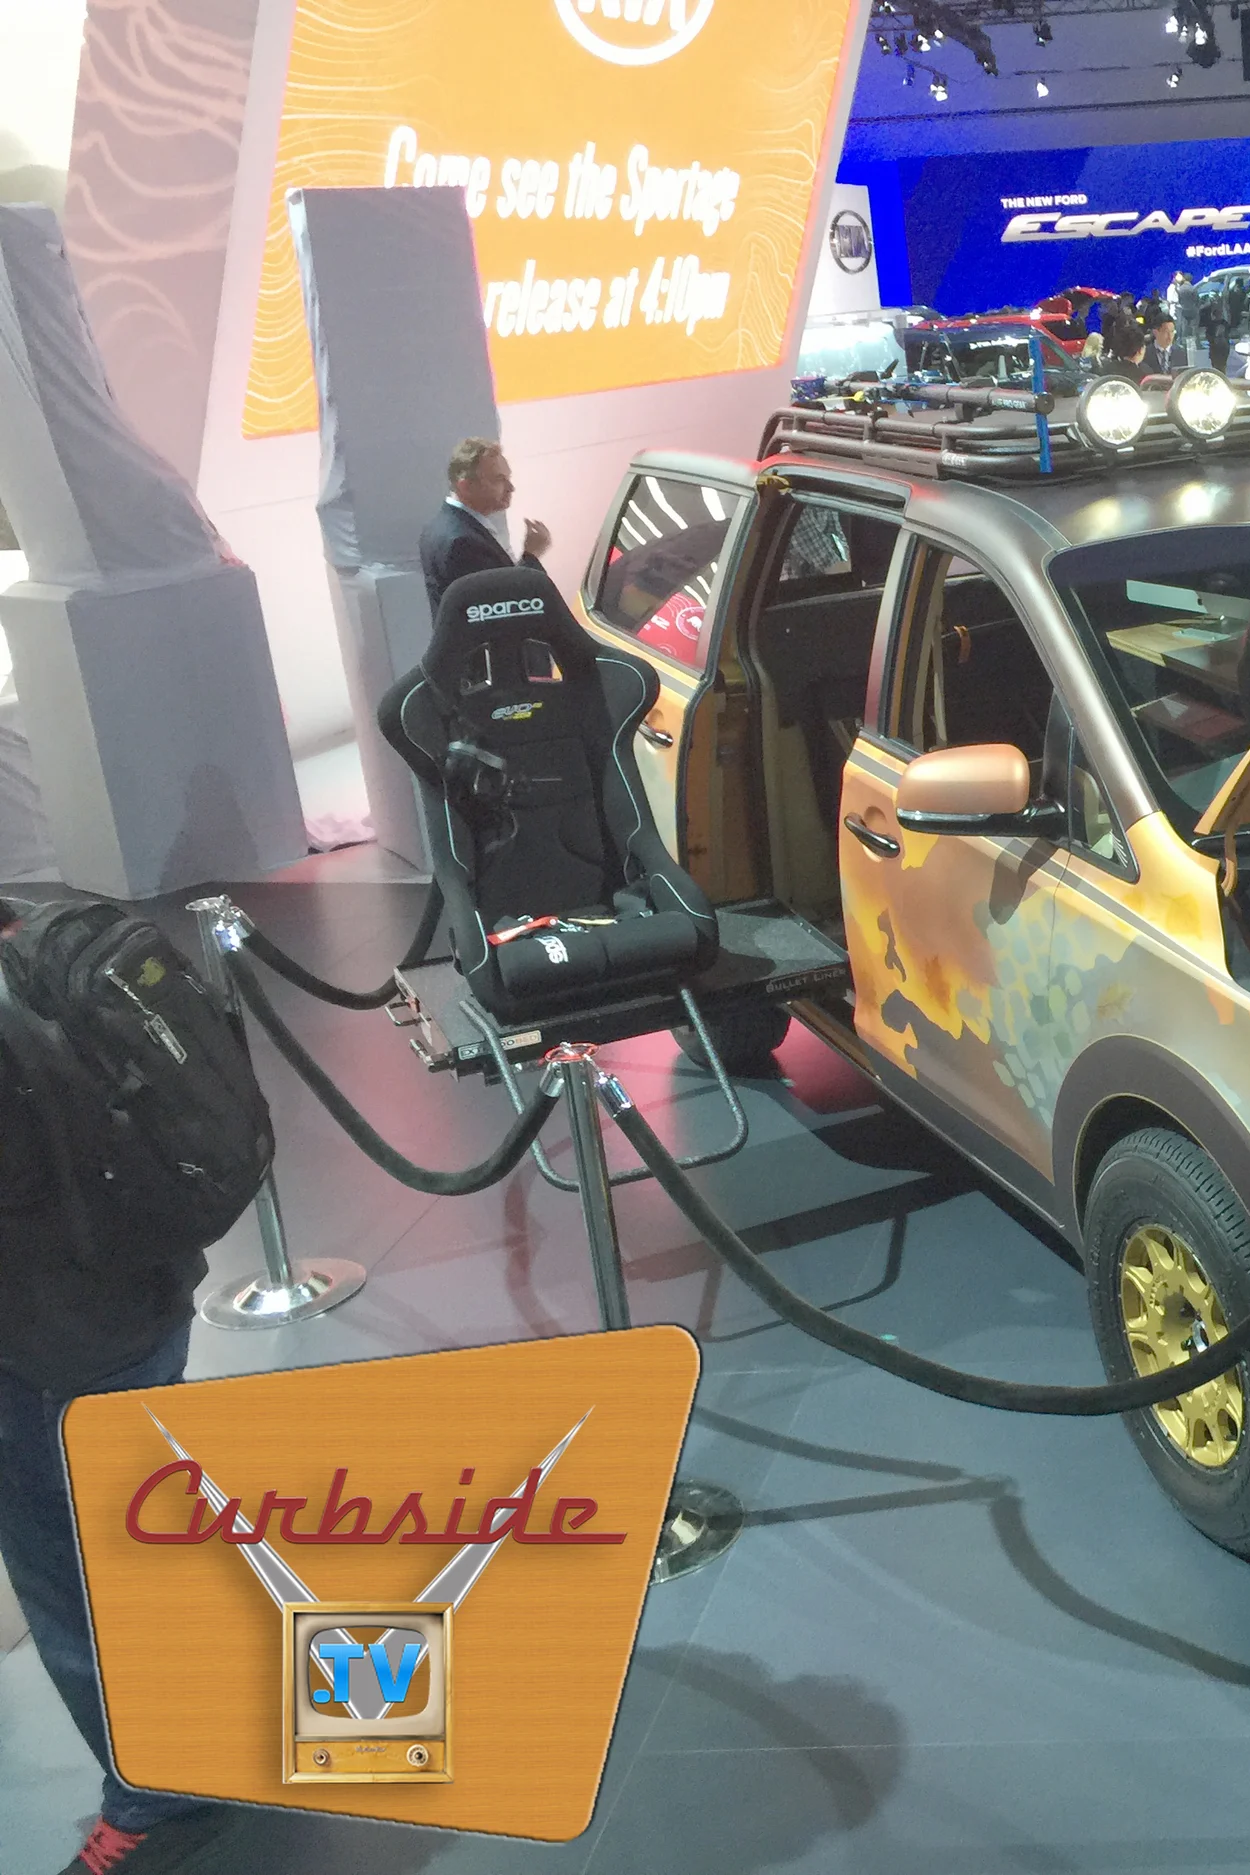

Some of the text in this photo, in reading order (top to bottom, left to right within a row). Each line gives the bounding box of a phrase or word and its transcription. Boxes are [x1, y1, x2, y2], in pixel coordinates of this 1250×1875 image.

[496, 157, 560, 219] see
[564, 140, 617, 219] the
[619, 143, 741, 237] Sportage
[1000, 194, 1088, 209] THE NEW FORD
[482, 254, 731, 338] release at 4:10pm
[466, 597, 545, 623] sparco
